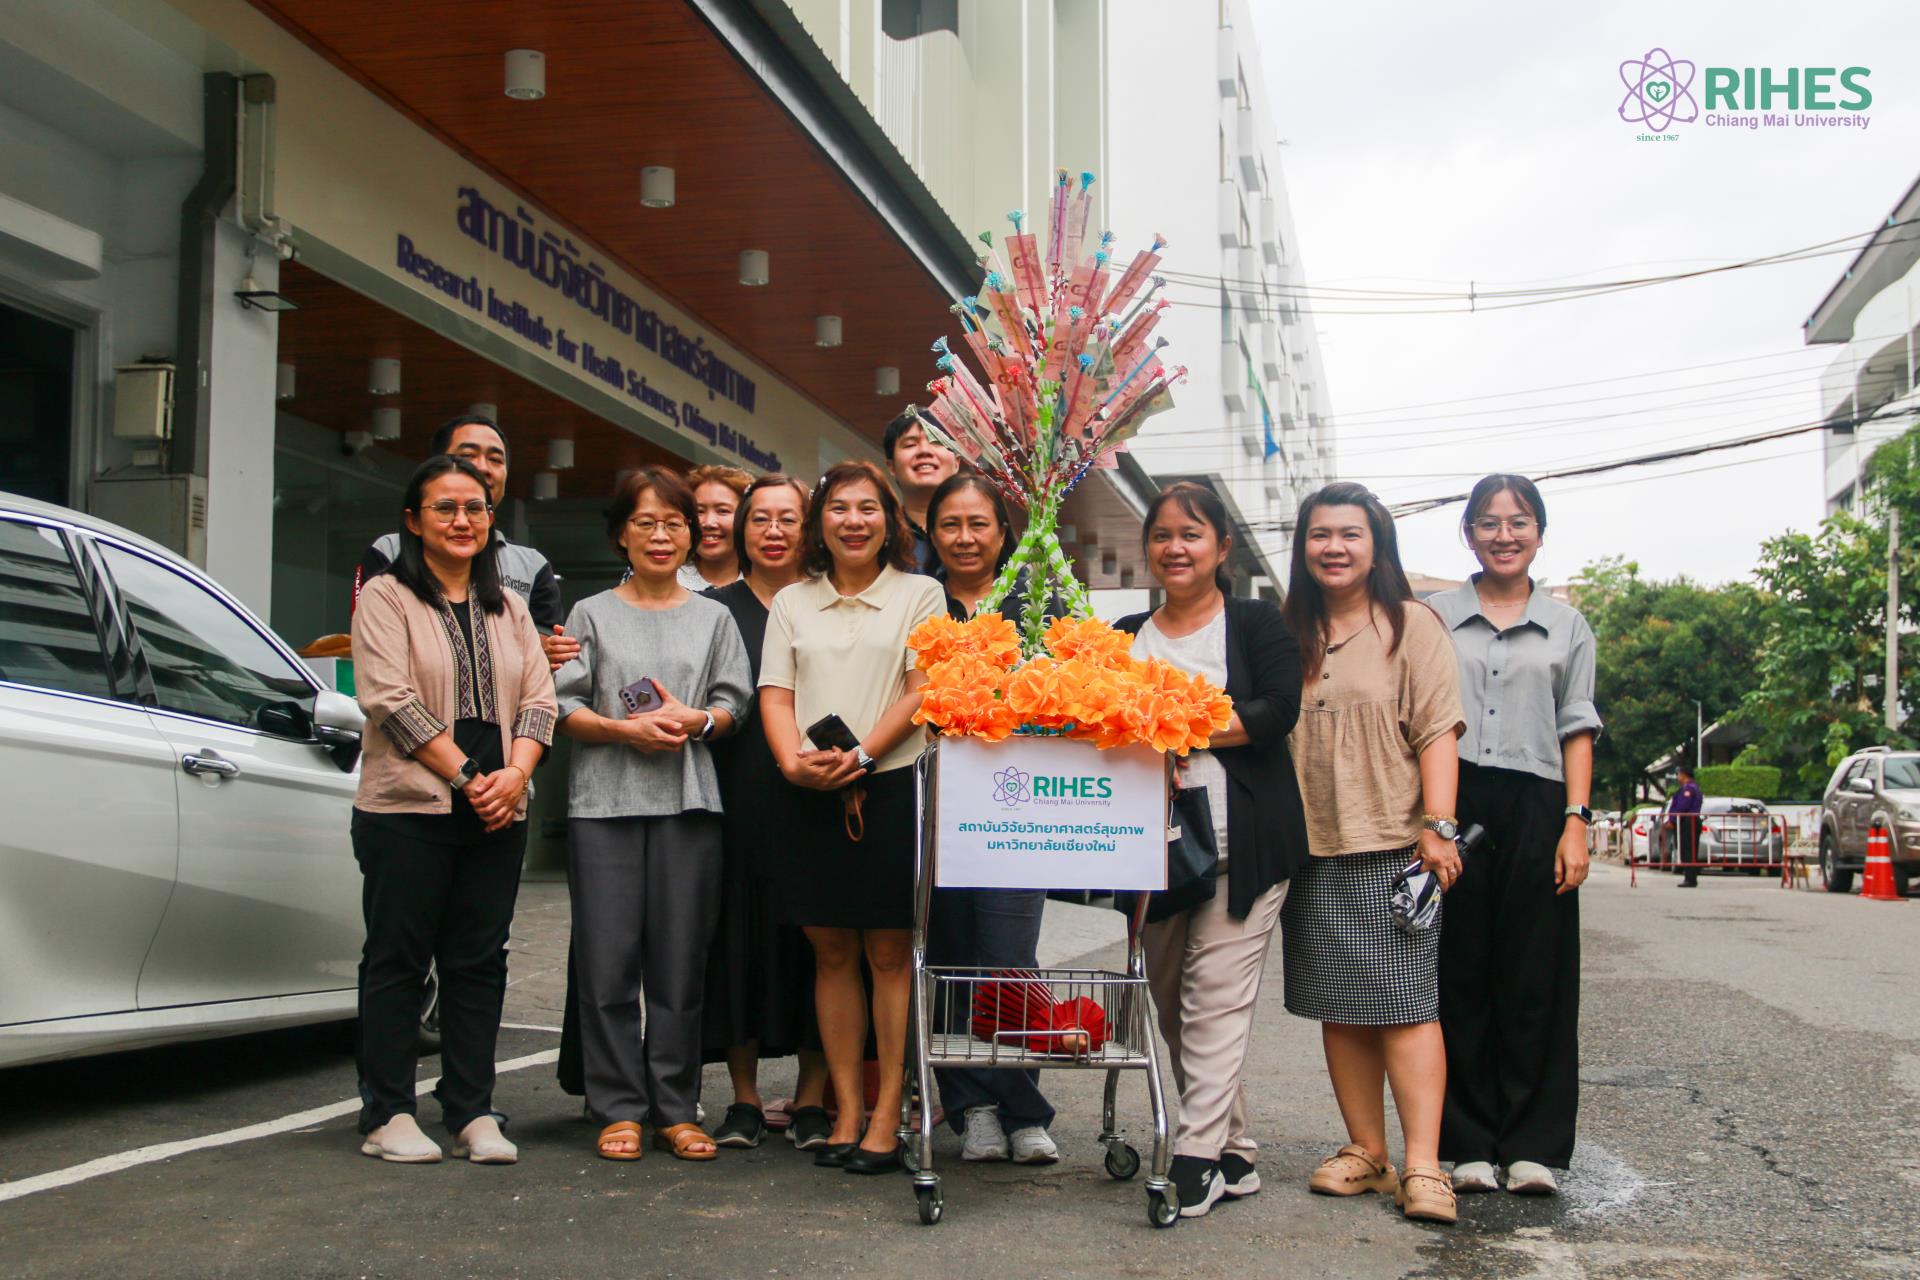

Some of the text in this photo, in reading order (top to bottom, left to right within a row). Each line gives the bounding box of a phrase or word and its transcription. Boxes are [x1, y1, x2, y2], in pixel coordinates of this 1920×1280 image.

[397, 233, 483, 311] Research
[488, 287, 552, 350] Institute
[557, 328, 579, 363] for
[582, 341, 624, 390] Health
[1033, 776, 1112, 798] RIHES
[1033, 798, 1058, 806] Chiang
[1075, 799, 1111, 807] University
[958, 820, 1144, 838] สถาบันวิจัยวิทยาศาสตร์สุขภาพ
[987, 839, 1116, 852] มหาวิทยาลัยเชียงใหม่
